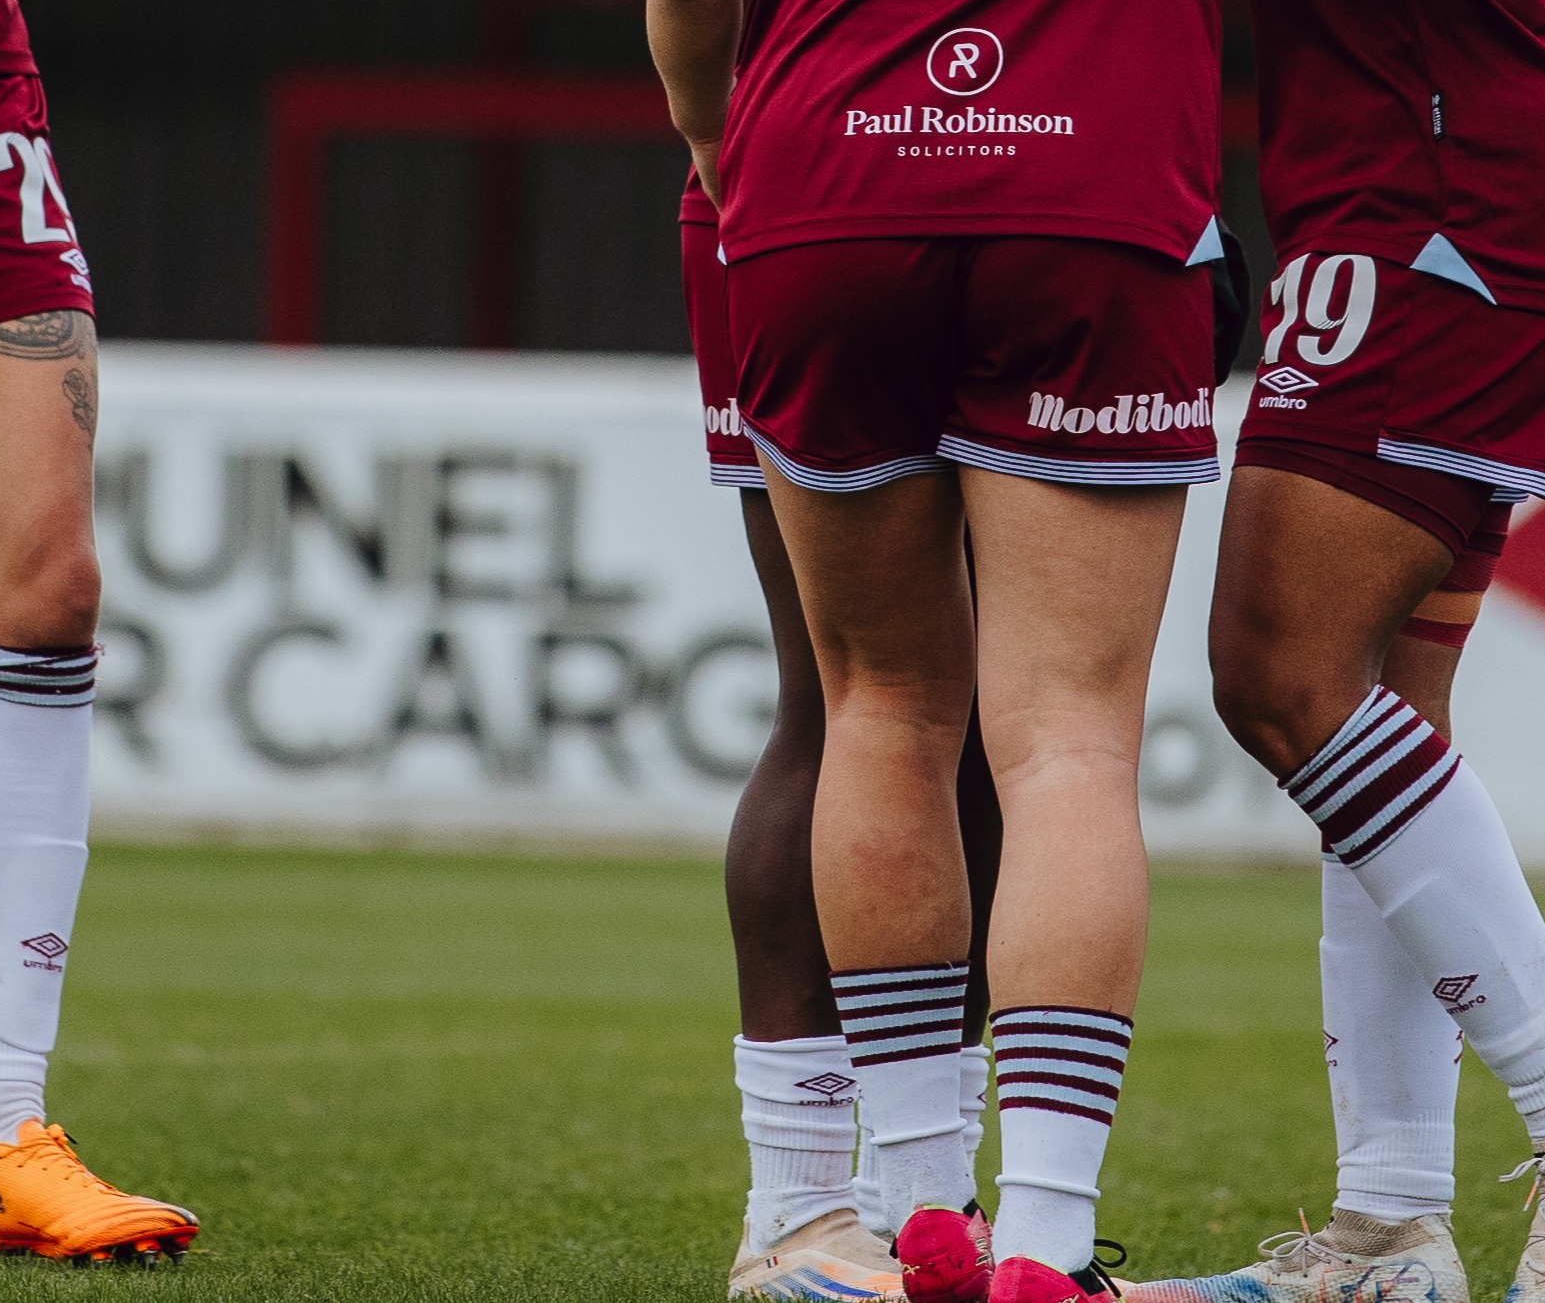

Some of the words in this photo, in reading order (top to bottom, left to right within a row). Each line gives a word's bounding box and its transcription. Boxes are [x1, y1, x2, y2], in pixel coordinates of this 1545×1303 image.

[844, 105, 913, 136] Paul
[920, 106, 1075, 135] Robinson
[897, 145, 1017, 157] SOLICITORS
[1262, 253, 1377, 366] 19
[1258, 394, 1308, 410] umbro
